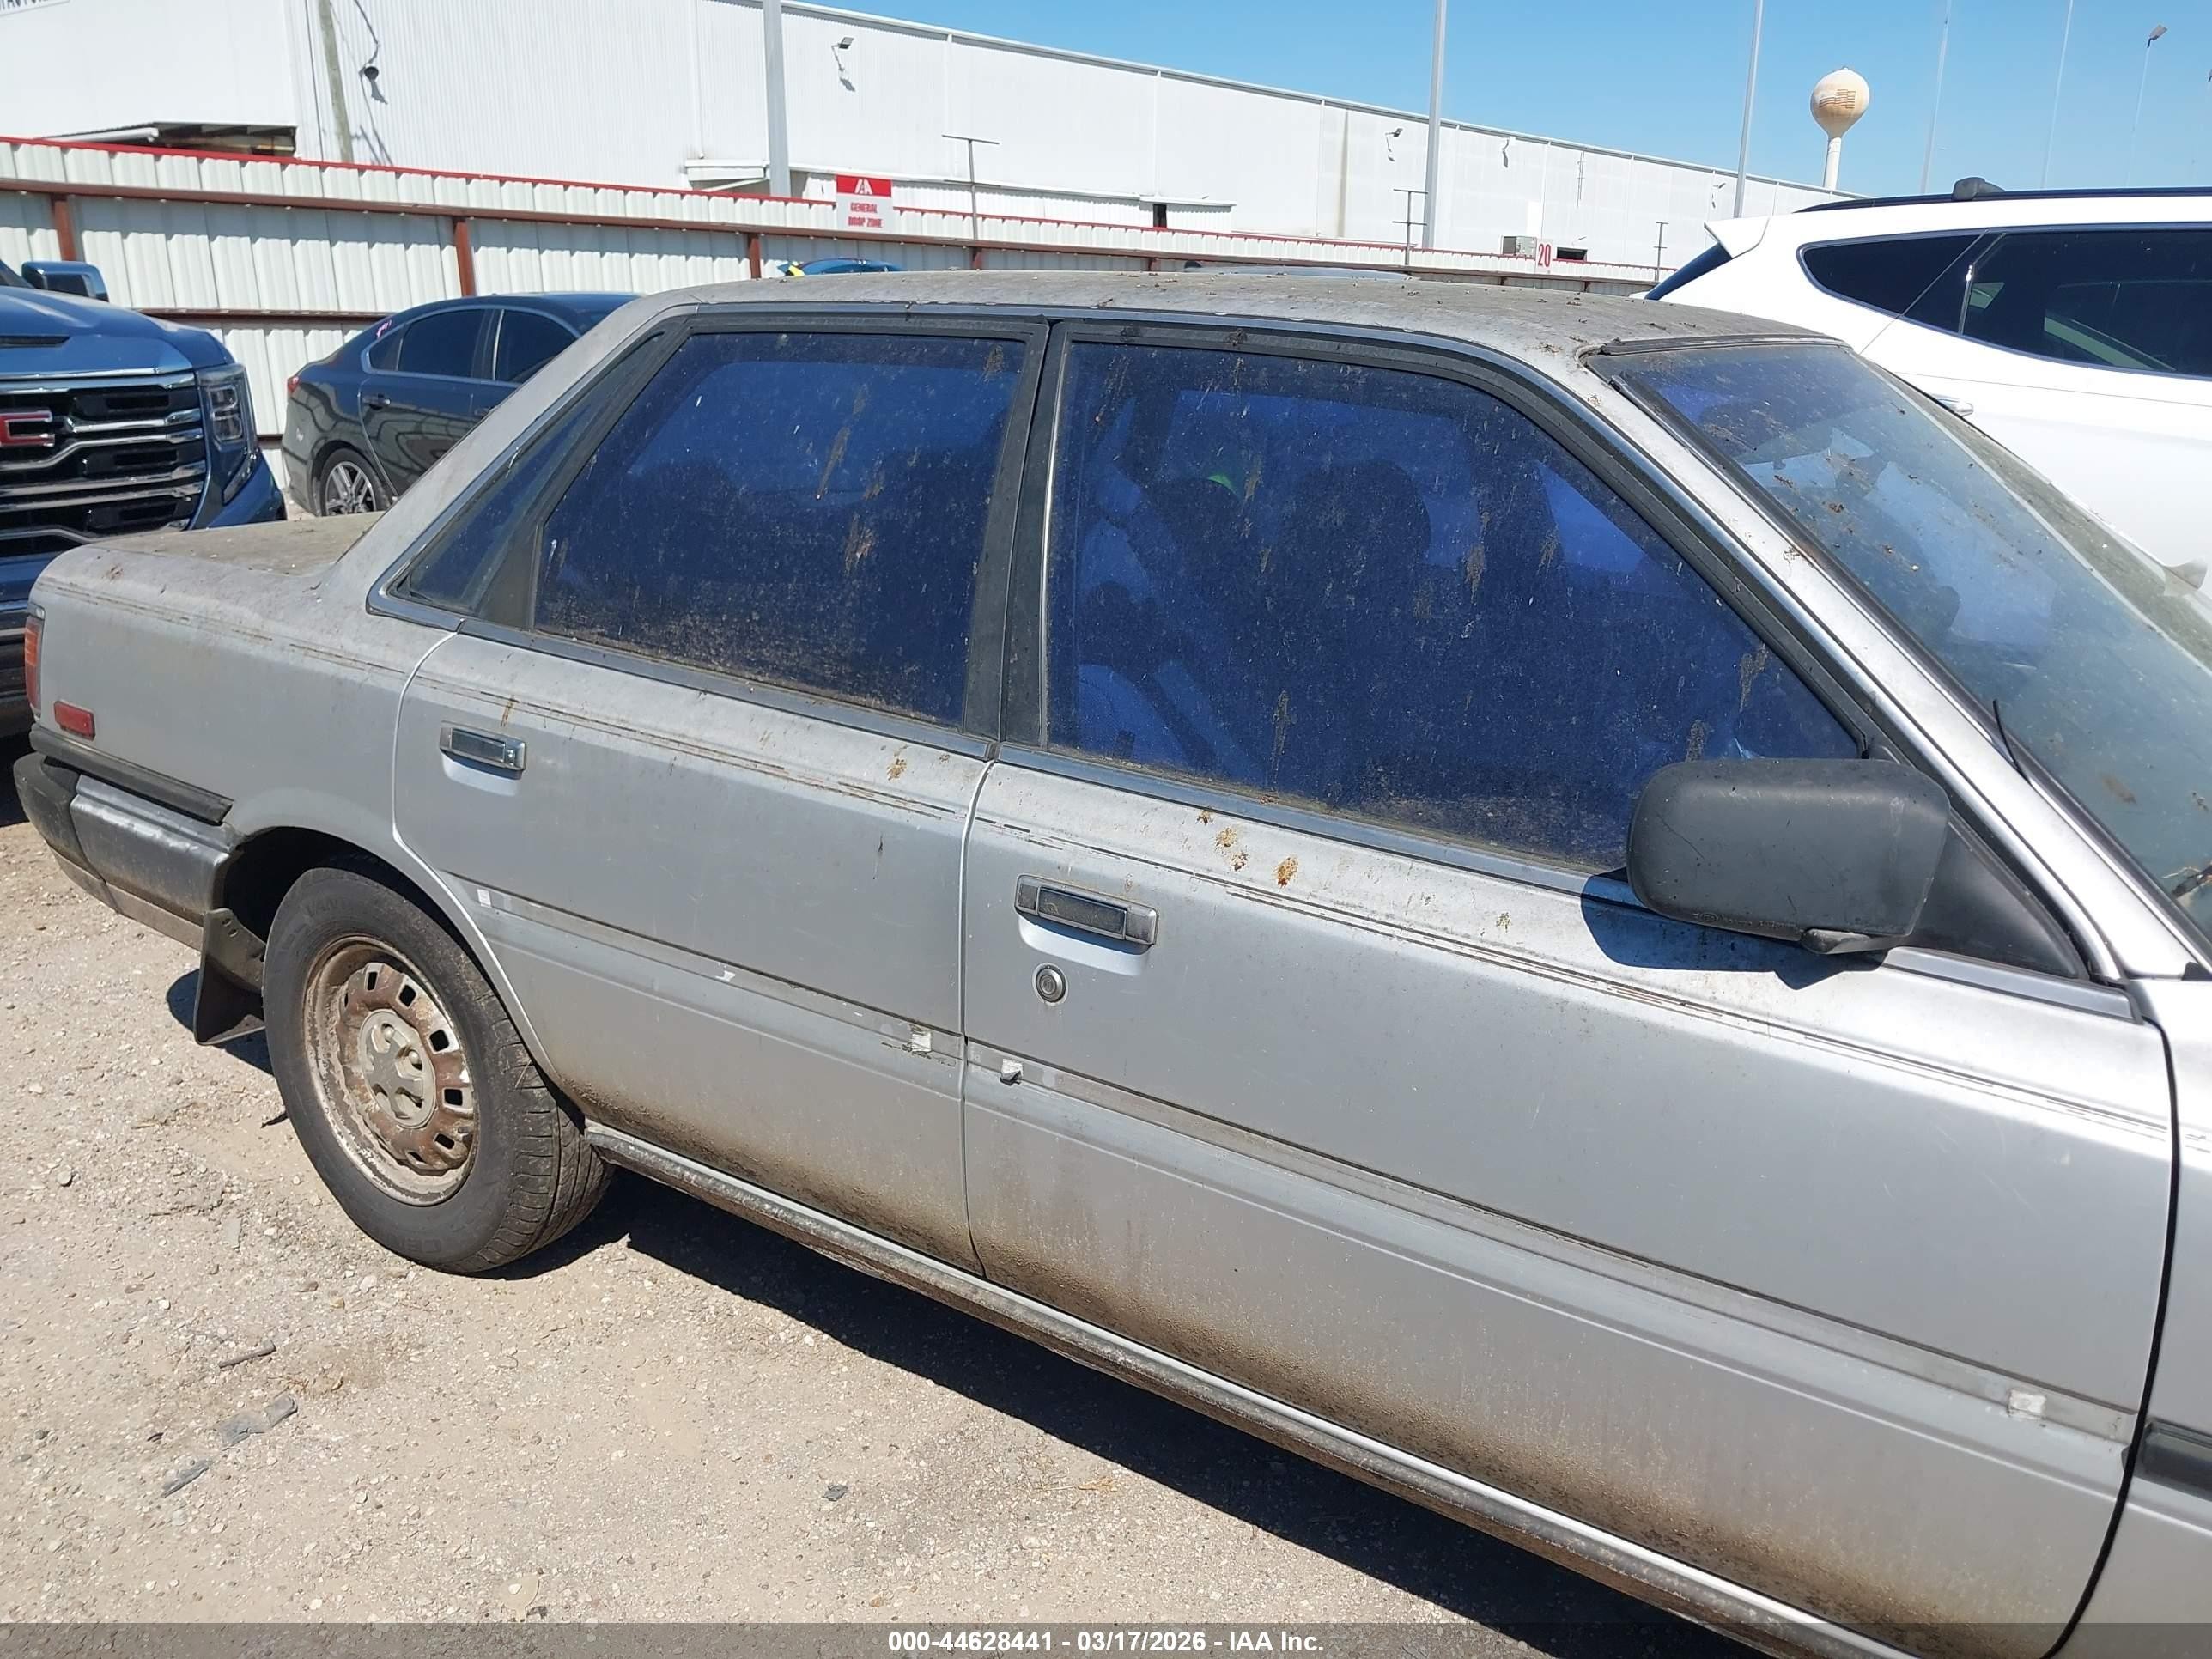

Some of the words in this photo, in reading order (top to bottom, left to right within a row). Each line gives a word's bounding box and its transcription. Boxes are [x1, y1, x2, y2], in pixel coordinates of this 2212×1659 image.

[851, 202, 878, 214] GENERAL
[848, 216, 866, 227] DROP
[866, 217, 883, 228] ZONE
[1538, 243, 1551, 267] 20
